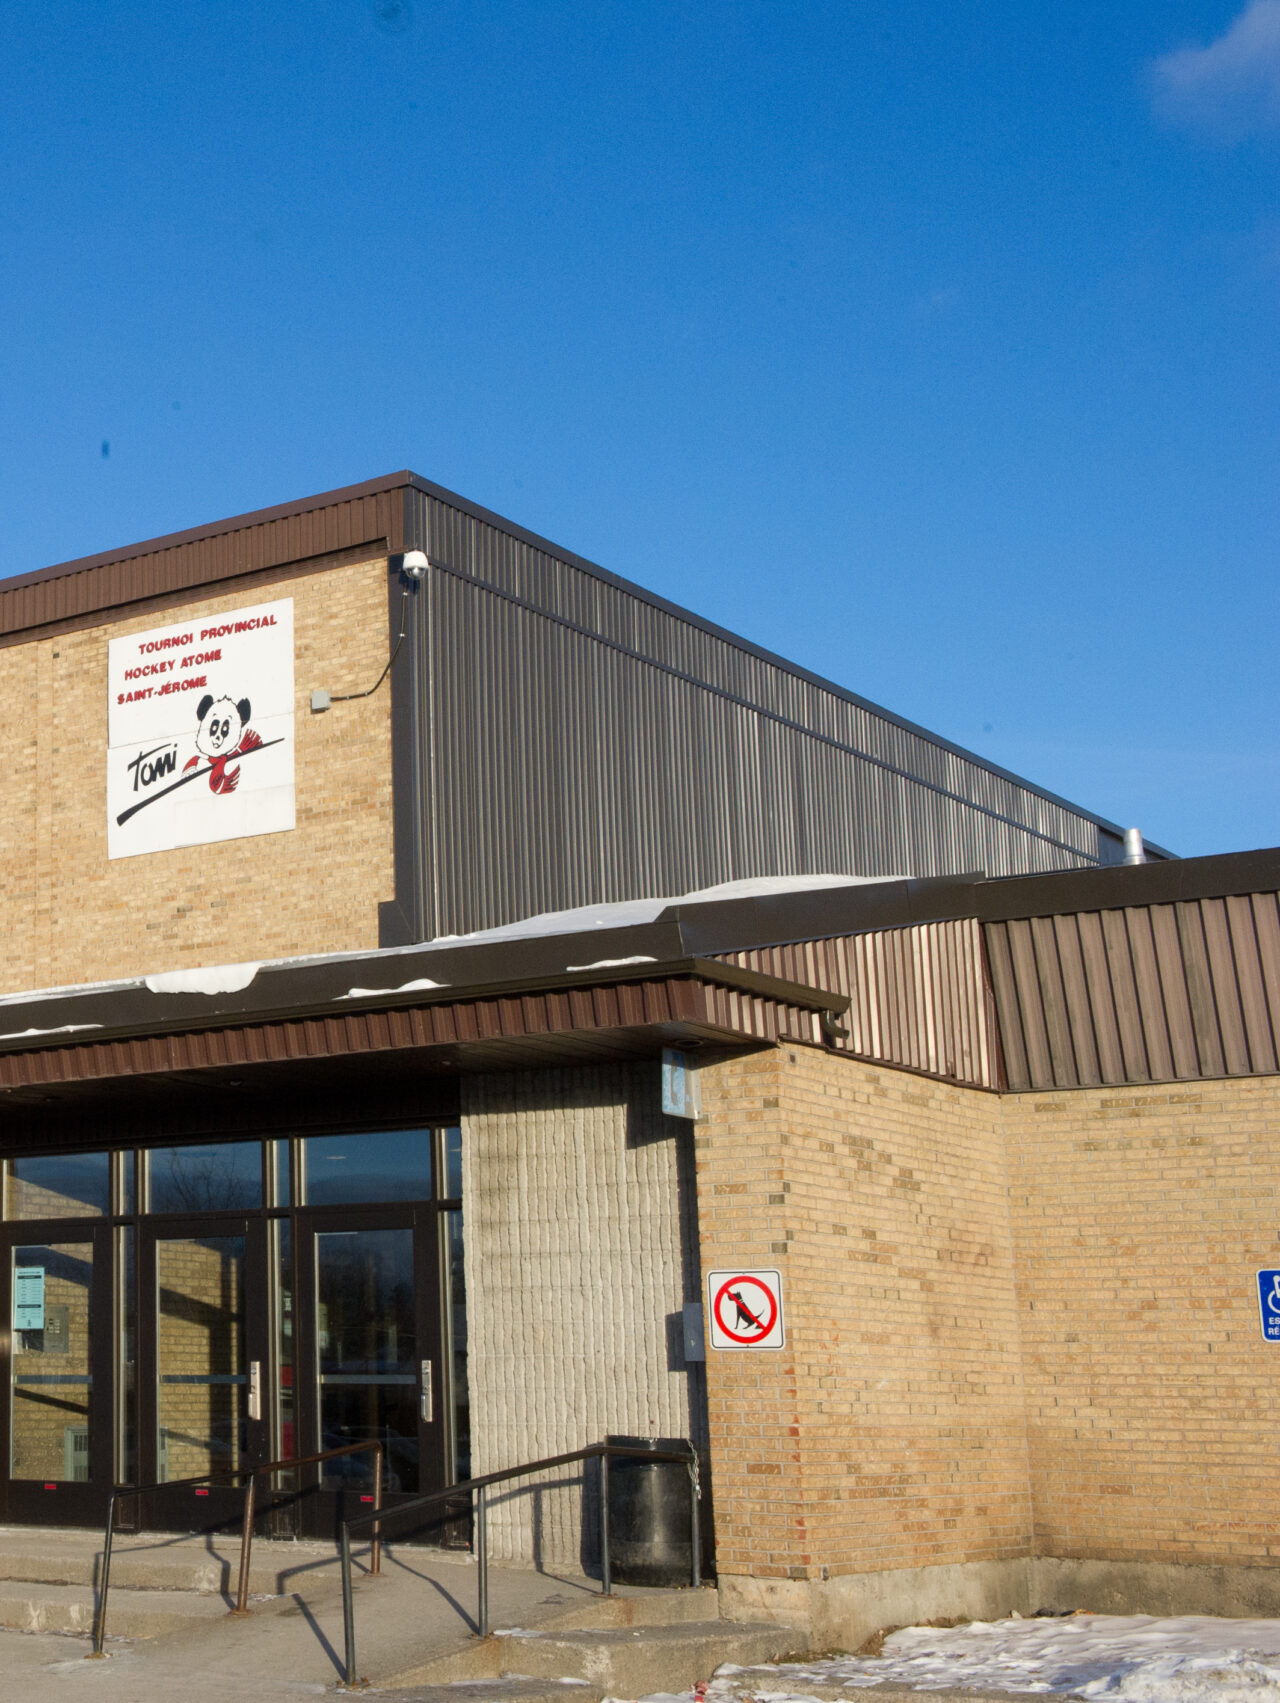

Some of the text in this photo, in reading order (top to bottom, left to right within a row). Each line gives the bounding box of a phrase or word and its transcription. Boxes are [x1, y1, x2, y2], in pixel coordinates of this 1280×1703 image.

[138, 614, 278, 655] TOURNOI PROVINCIAL
[124, 648, 222, 681] HOCKEY ATOME
[117, 676, 208, 705] SAINT-JÉROME
